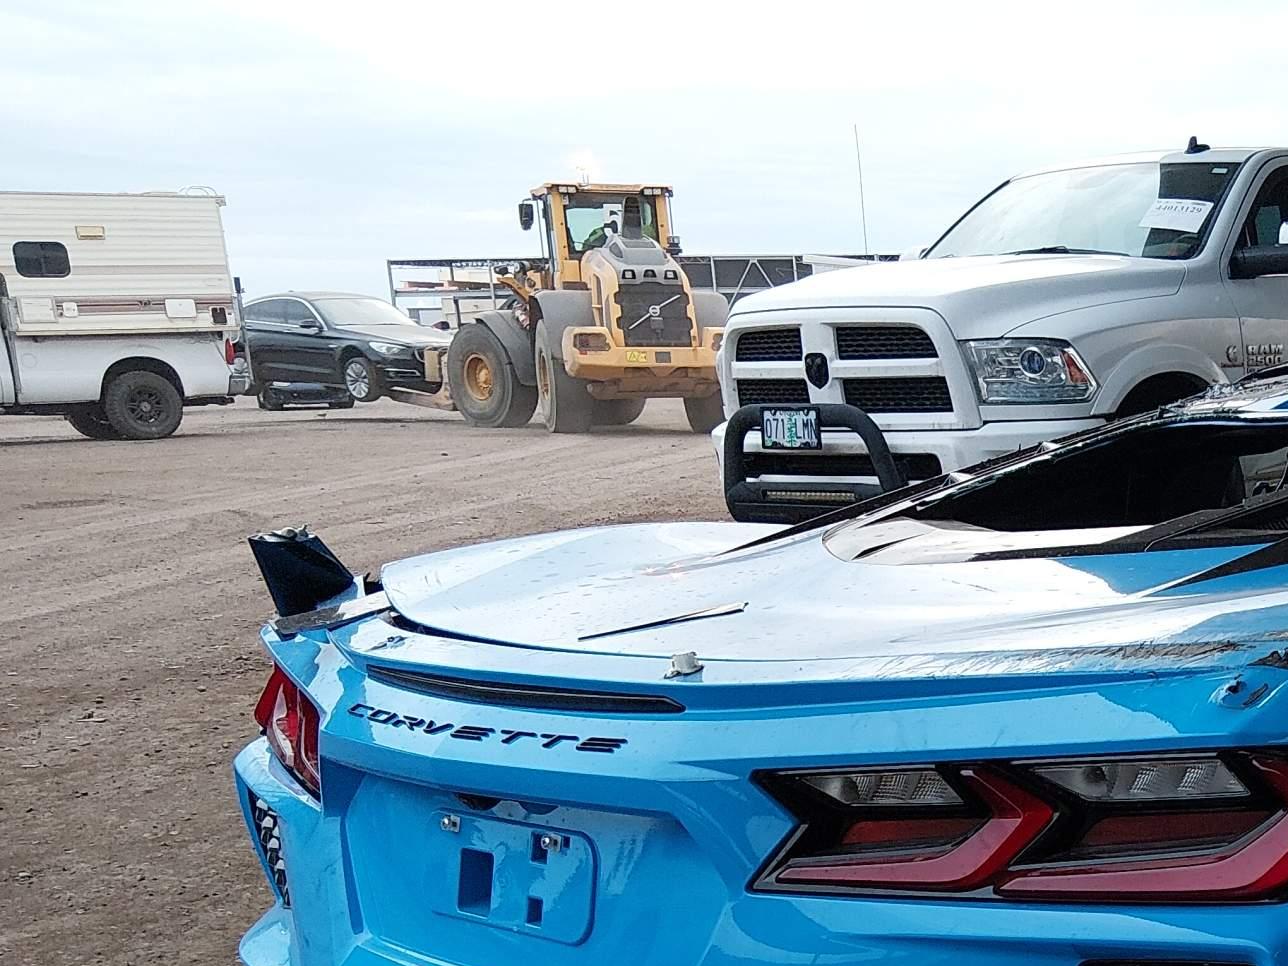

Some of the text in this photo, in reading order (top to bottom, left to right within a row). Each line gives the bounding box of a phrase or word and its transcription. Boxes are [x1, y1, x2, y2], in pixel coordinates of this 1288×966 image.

[1246, 343, 1283, 356] RAM
[765, 418, 817, 440] 071 LMN
[346, 702, 629, 755] CORVETTE
